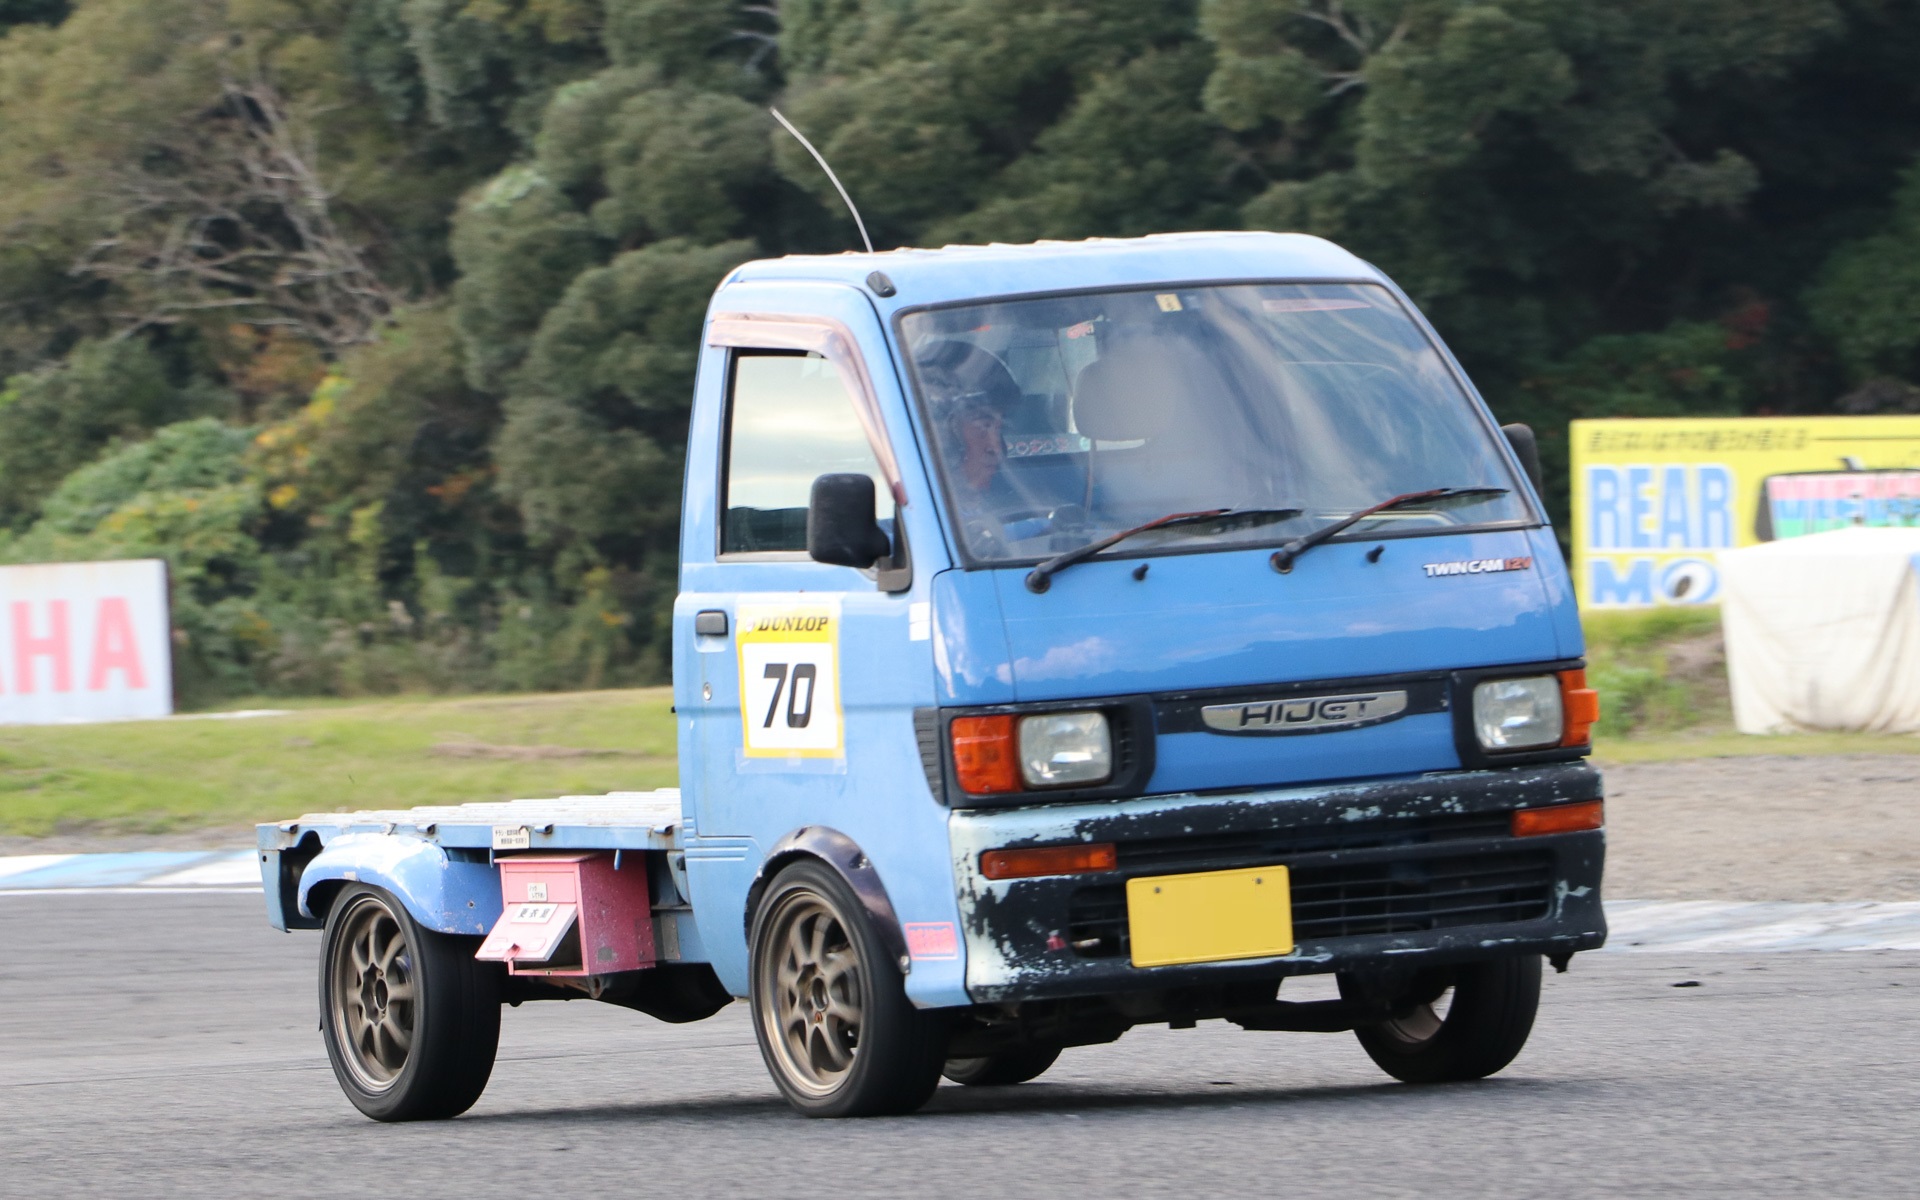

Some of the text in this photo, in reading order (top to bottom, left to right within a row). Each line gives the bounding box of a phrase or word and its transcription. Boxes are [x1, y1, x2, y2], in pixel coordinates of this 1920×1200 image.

[1587, 465, 1735, 550] REAR
[0, 596, 150, 695] HA
[758, 616, 829, 632] DUNLOP
[763, 663, 817, 729] 70
[1239, 696, 1379, 727] HIJET
